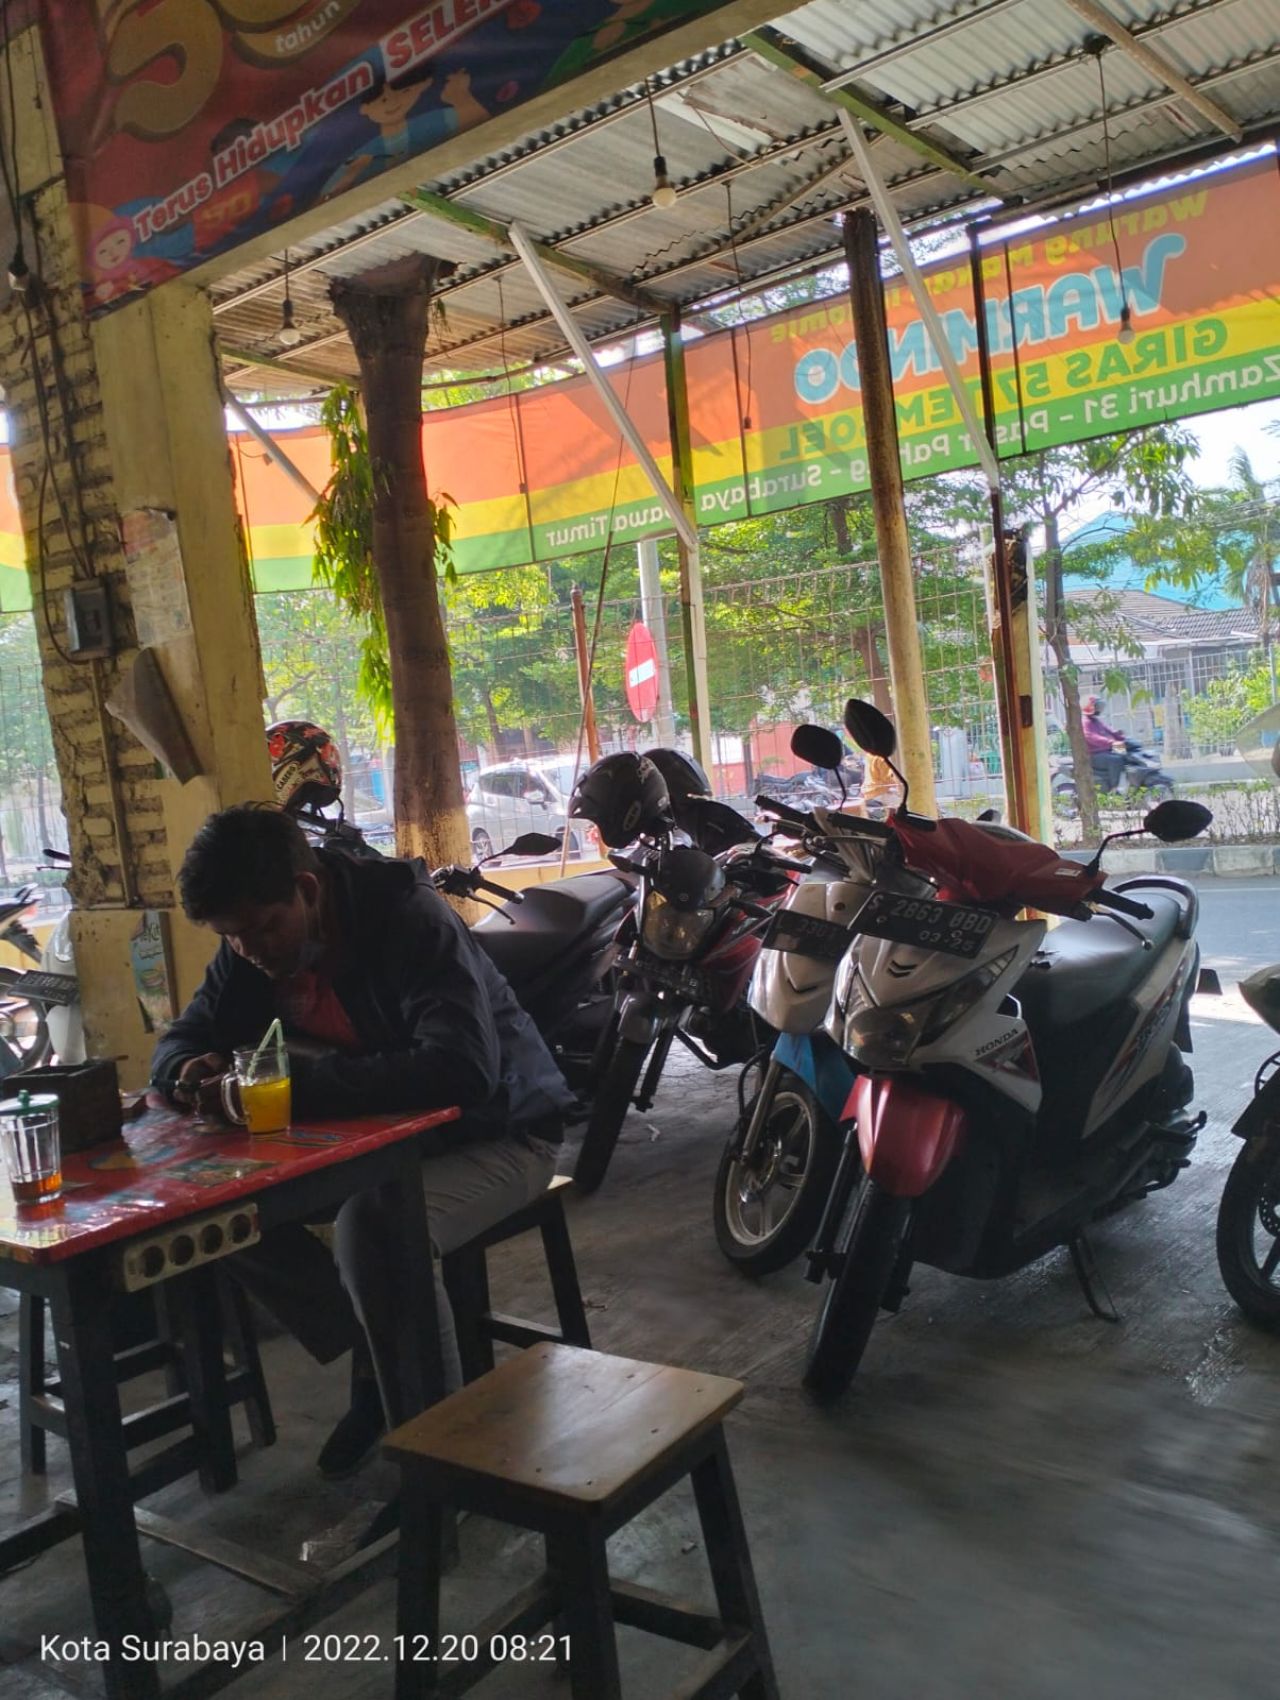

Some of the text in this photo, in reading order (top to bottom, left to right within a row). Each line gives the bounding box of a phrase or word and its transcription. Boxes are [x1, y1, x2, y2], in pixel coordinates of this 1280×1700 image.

[275, 1, 340, 53] tahun
[133, 174, 213, 242] Terus
[214, 63, 373, 187] Hidupkan
[975, 1028, 1019, 1057] HONDA
